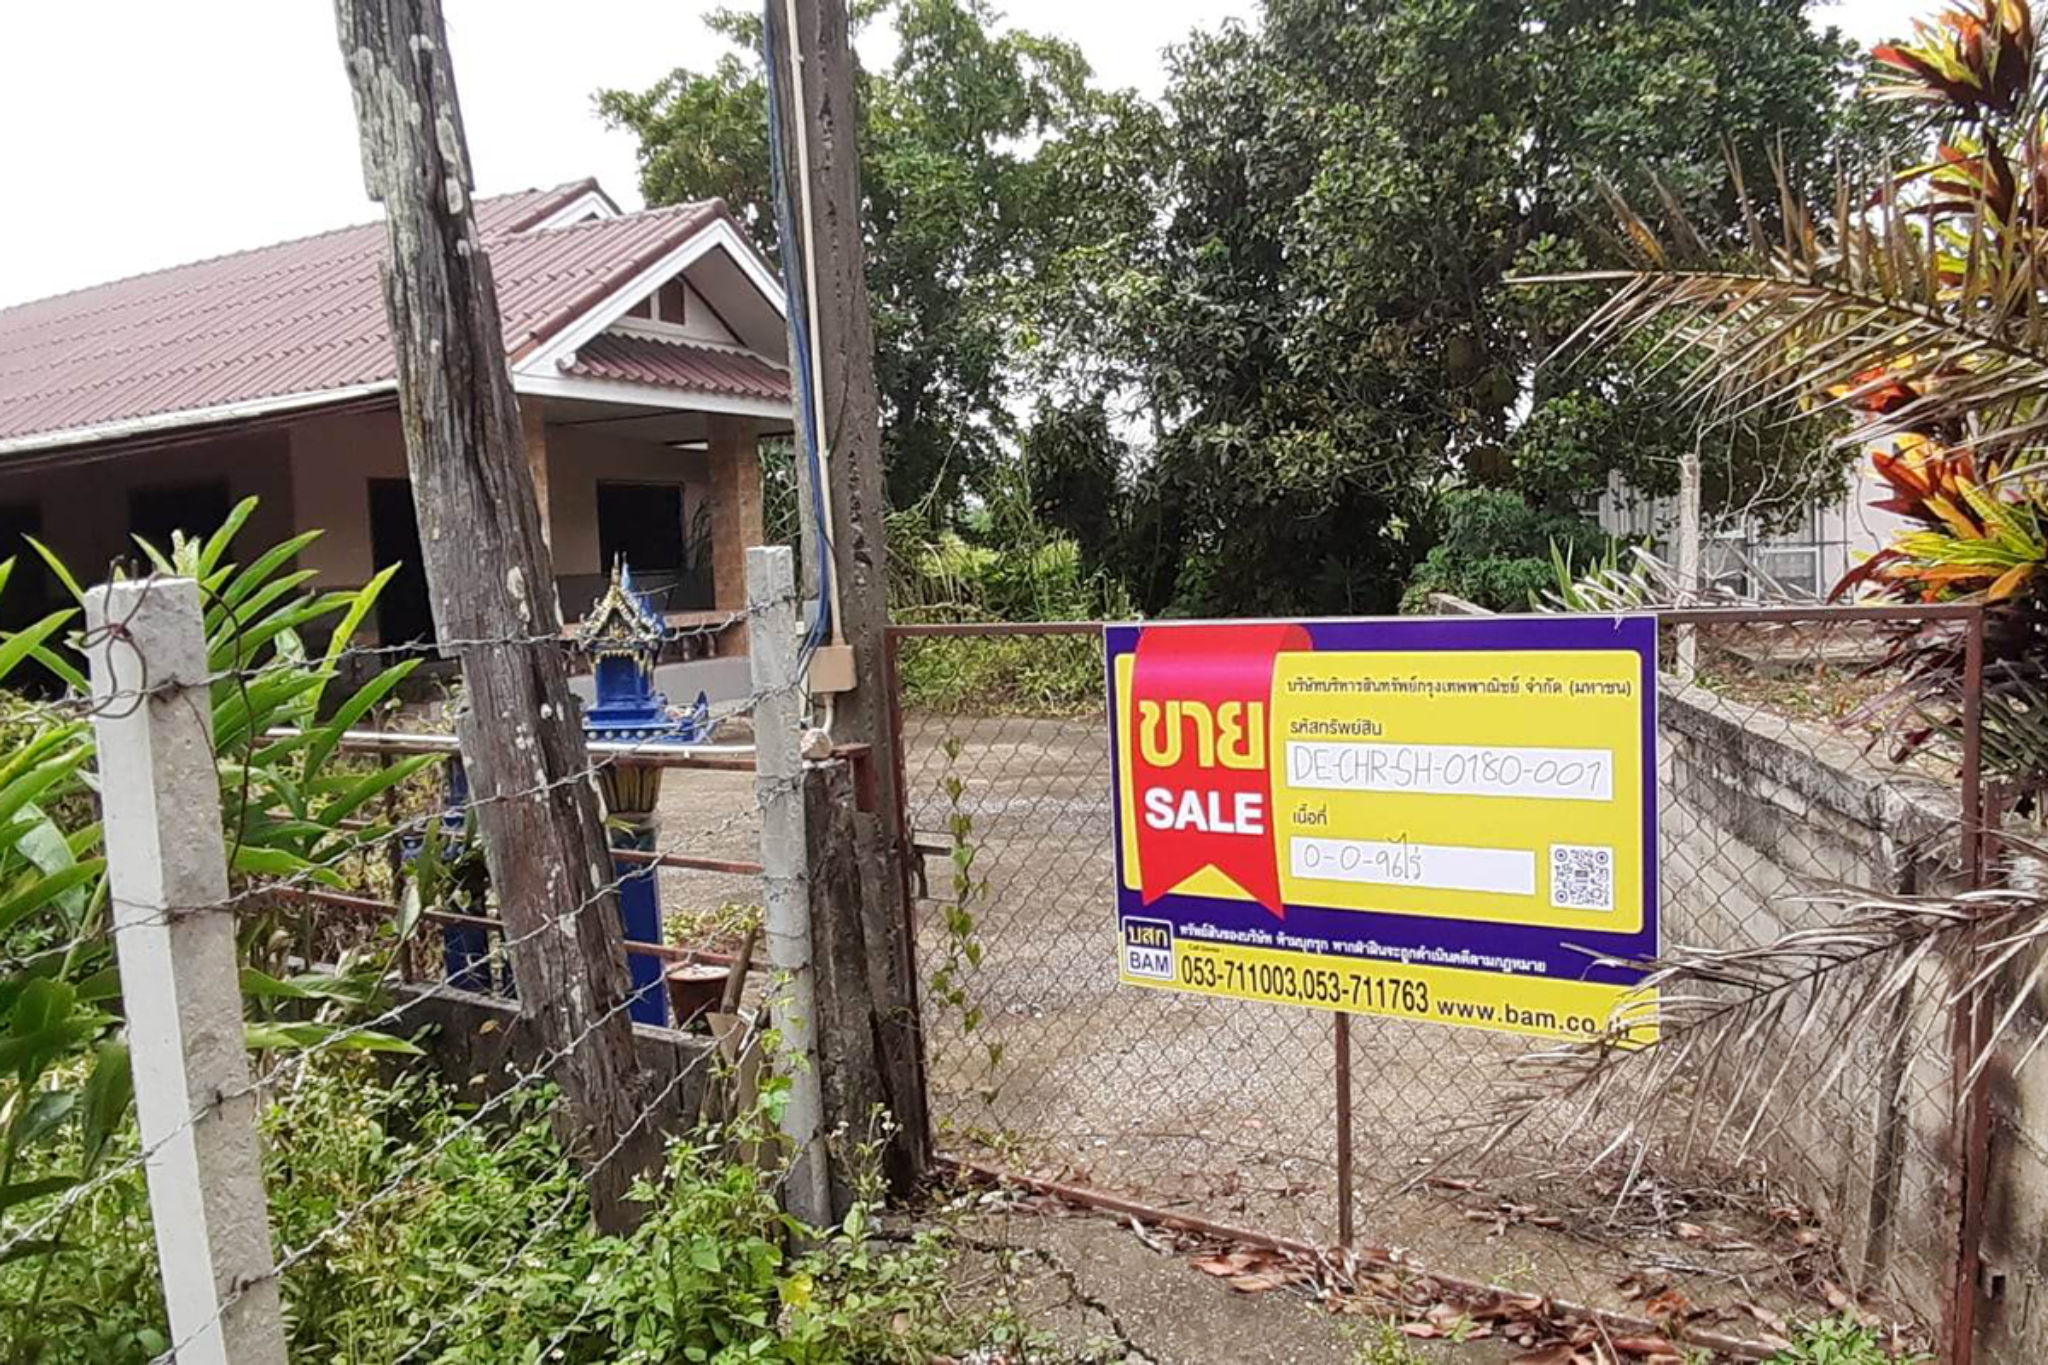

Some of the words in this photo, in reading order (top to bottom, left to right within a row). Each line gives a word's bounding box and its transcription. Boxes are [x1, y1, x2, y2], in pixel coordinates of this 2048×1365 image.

[1525, 676, 1562, 694] จำกัด
[1569, 679, 1632, 698] (มหาชน)
[1138, 699, 1266, 770] ขาย
[1290, 718, 1383, 736] รหัสทรัพย์สิน
[1144, 787, 1265, 835] SALE
[1293, 803, 1327, 825] เนื้อที่
[1127, 925, 1168, 948] บสก
[1130, 951, 1169, 973] BAM
